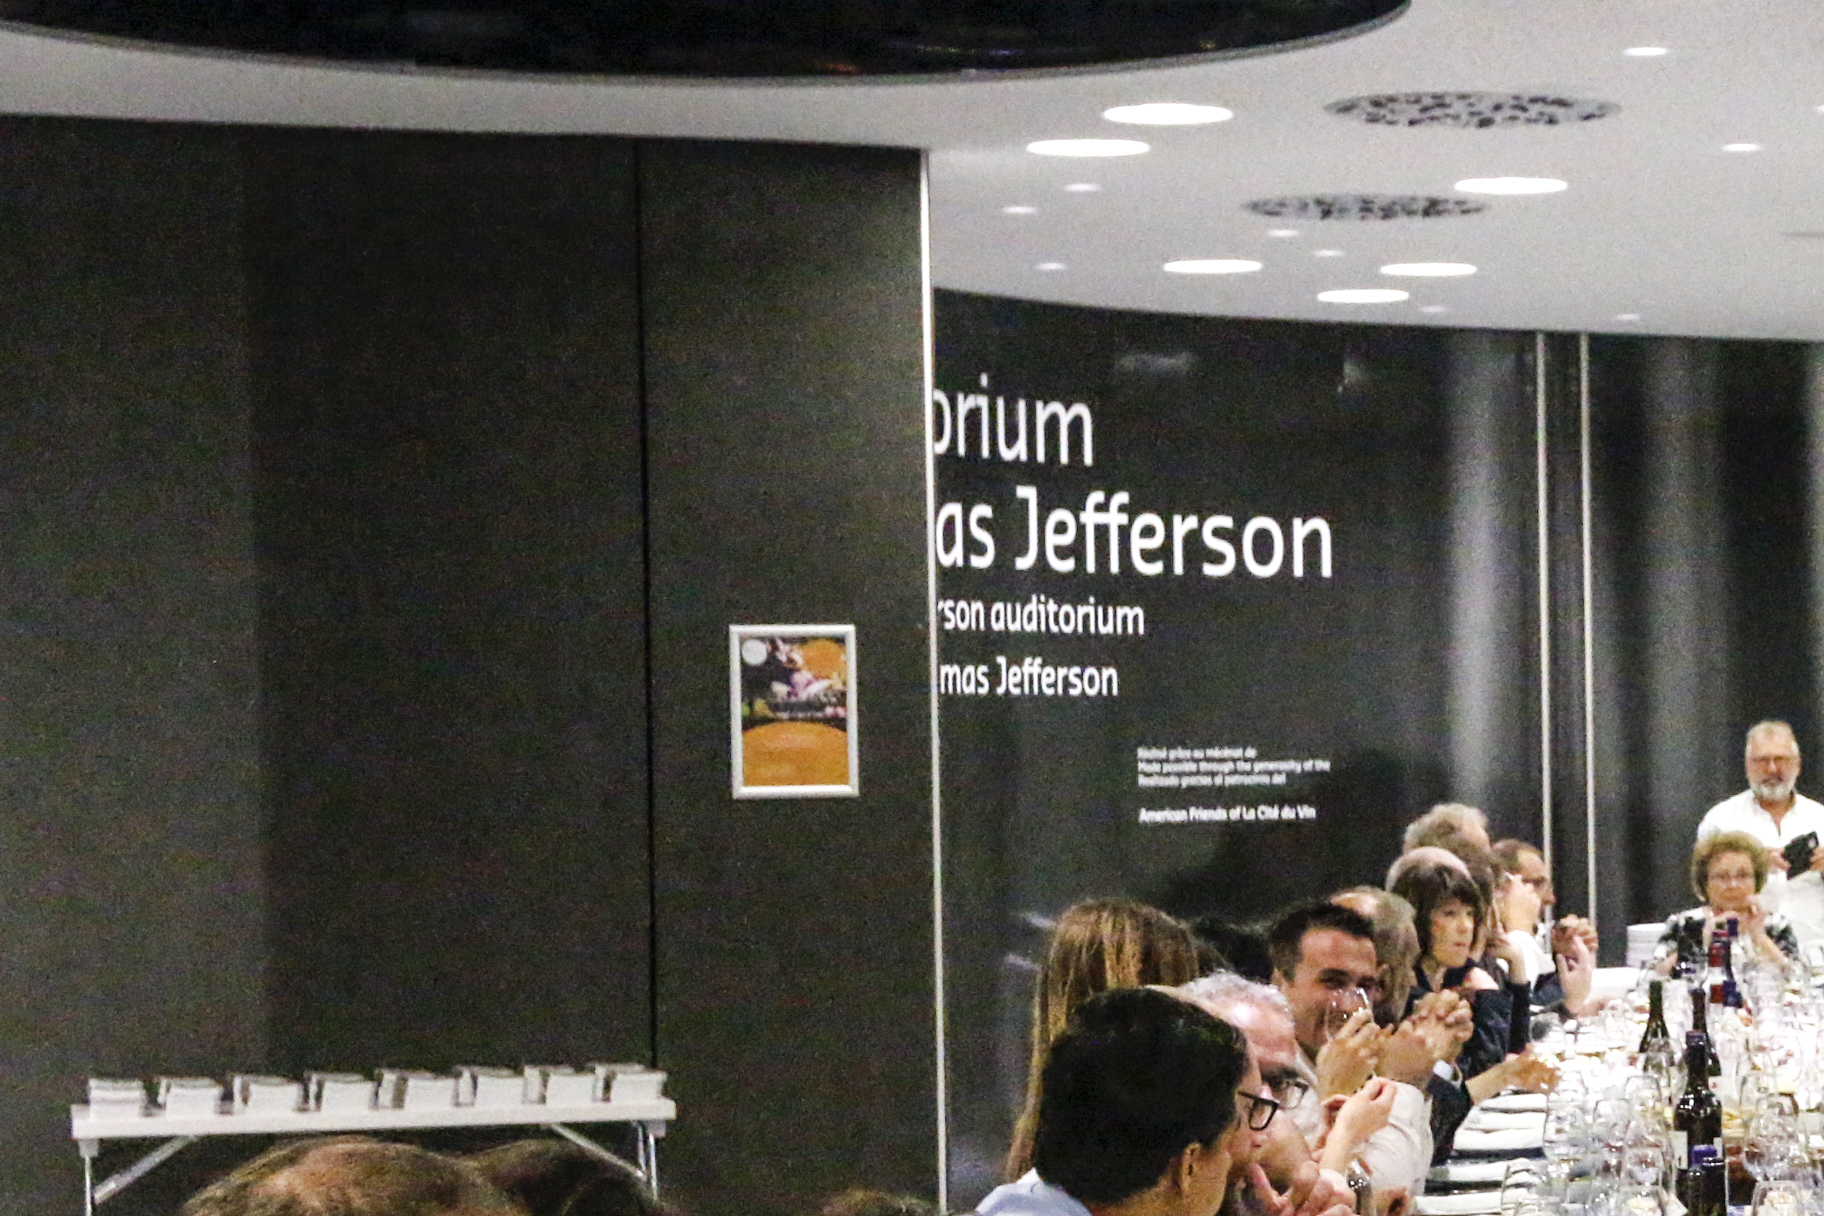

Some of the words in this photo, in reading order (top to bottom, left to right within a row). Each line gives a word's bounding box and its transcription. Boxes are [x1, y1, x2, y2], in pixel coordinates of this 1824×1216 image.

[935, 500, 995, 570] as
[1014, 485, 1333, 578] Jefferson
[990, 595, 1145, 636] auditorium
[940, 664, 990, 695] mas
[996, 655, 1119, 697] Jefferson
[1139, 807, 1188, 823] American
[1189, 806, 1228, 822] Friends
[1229, 805, 1241, 821] of
[1242, 806, 1256, 820] La
[1280, 804, 1296, 820] du
[1297, 804, 1316, 820] Vin
